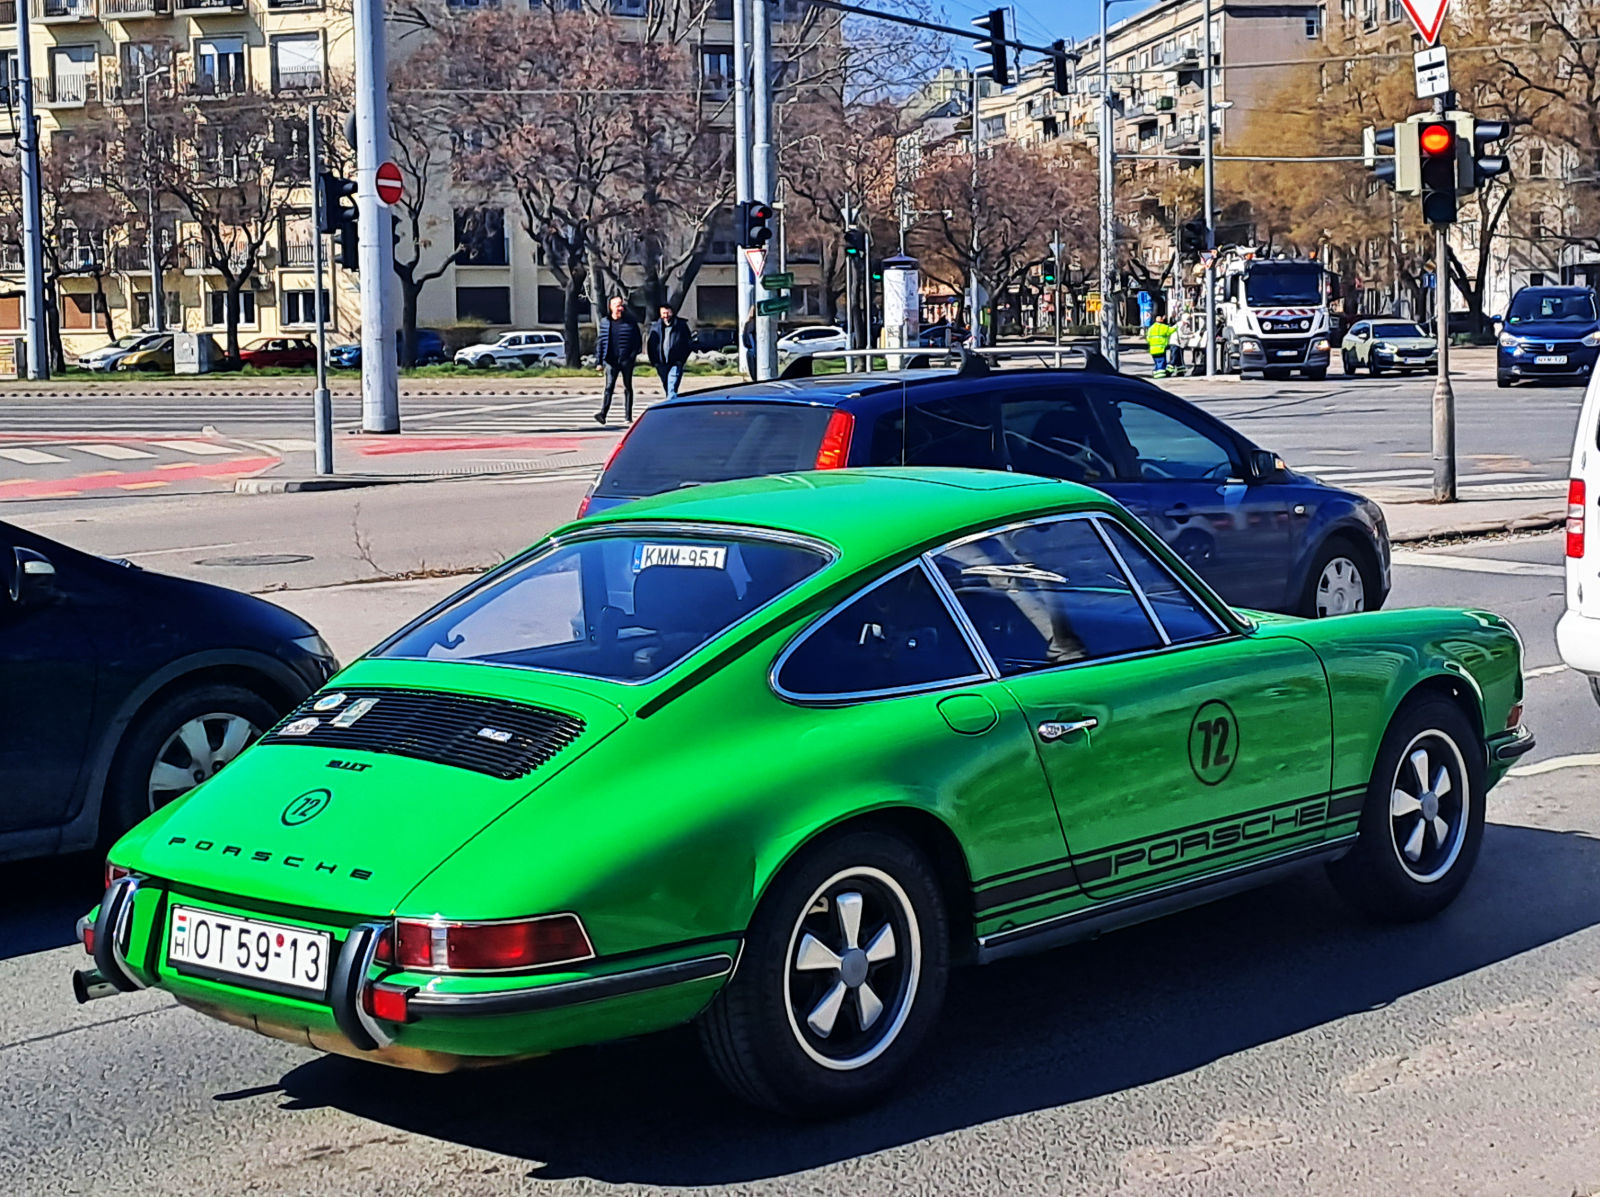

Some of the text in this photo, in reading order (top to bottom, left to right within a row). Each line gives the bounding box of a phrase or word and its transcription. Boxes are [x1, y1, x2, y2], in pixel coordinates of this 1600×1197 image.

[645, 548, 718, 567] KMM-951
[1197, 716, 1230, 769] 72
[291, 797, 321, 817] 72
[1113, 801, 1326, 876] PORSCHE
[168, 837, 373, 880] PORSCHE
[174, 935, 184, 956] H
